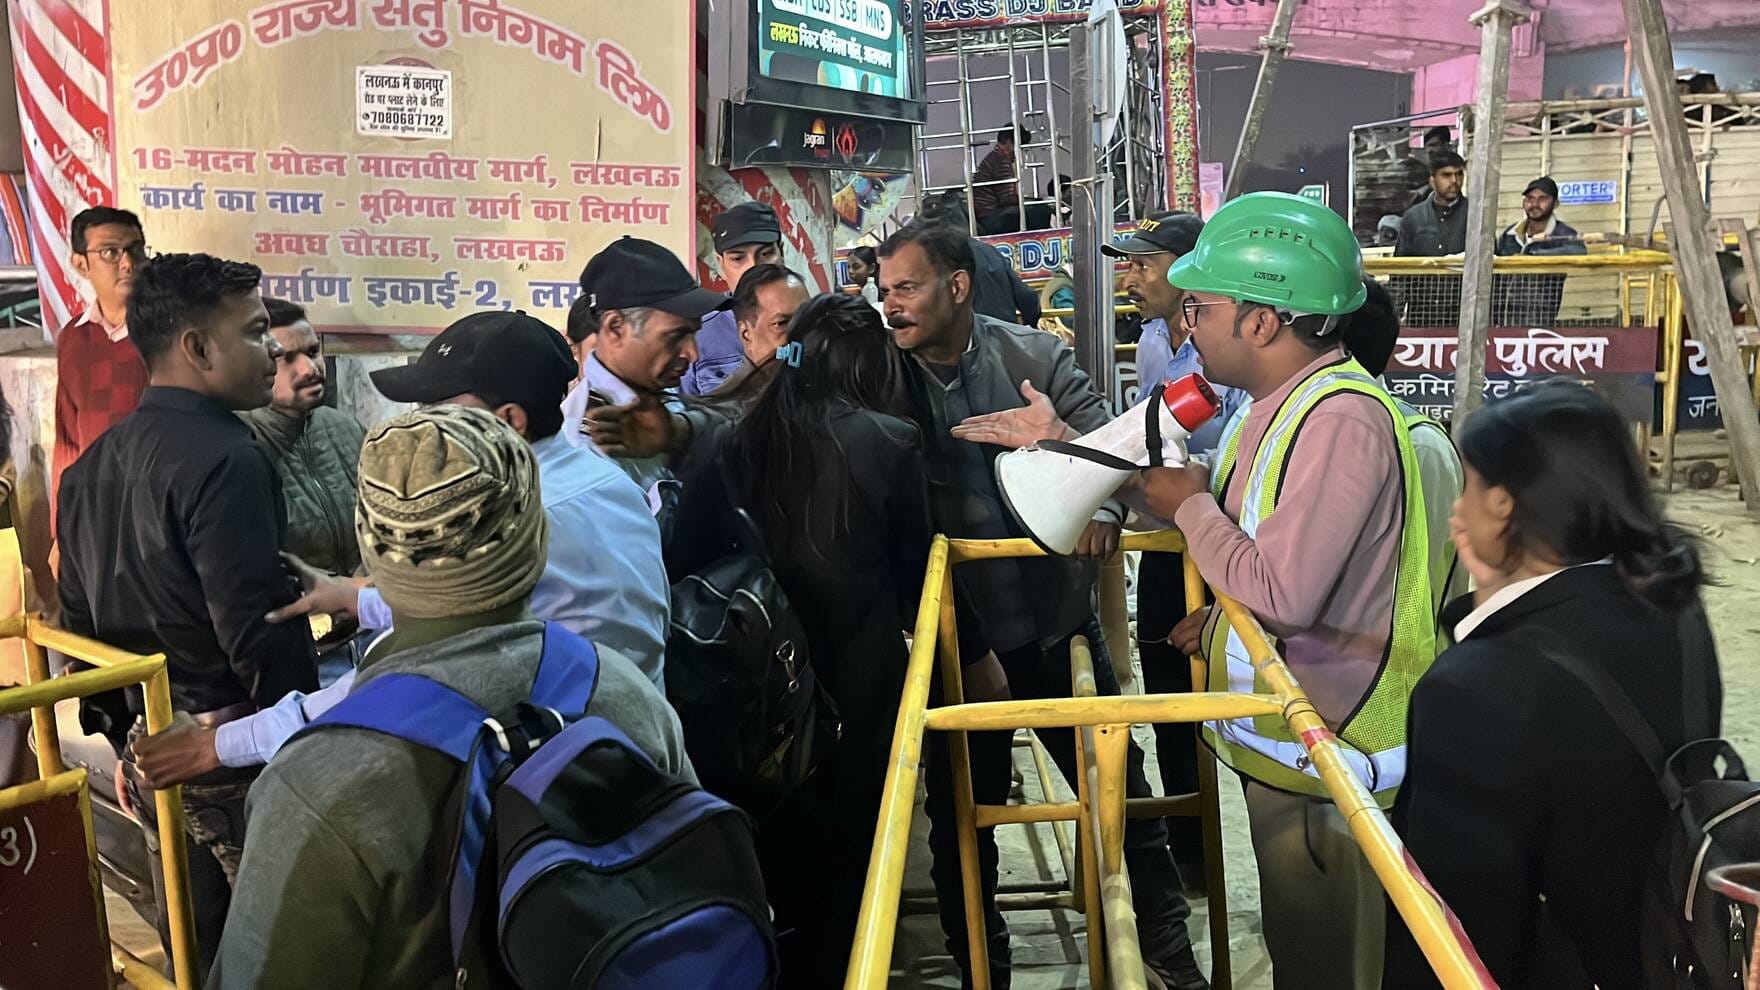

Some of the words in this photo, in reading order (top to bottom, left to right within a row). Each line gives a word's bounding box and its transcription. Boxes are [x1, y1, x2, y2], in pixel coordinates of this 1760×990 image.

[253, 0, 357, 44] राज्य
[1006, 0, 1048, 17] DJ
[365, 74, 400, 89] लखनऊ
[402, 72, 413, 90] में
[413, 77, 444, 96] कानपुर
[370, 111, 444, 127] 7080687722
[133, 148, 256, 173] 16-मदन
[266, 147, 347, 176] मोहन
[357, 153, 478, 181] मालवीय
[487, 156, 557, 188] मार्ग,
[570, 163, 681, 187] लखनऊ
[139, 183, 205, 210] कार्य
[215, 190, 256, 212] का
[266, 192, 323, 214] नाम
[361, 189, 456, 223] भूमिगत
[466, 193, 521, 220] मार्ग
[531, 200, 570, 222] का
[579, 196, 669, 225] निर्माण
[1557, 183, 1608, 194] ORTER
[340, 229, 439, 262] चौराहा,
[453, 238, 565, 262] लखनऊ
[1020, 238, 1062, 271] DJ
[1493, 329, 1609, 377] पुलिस
